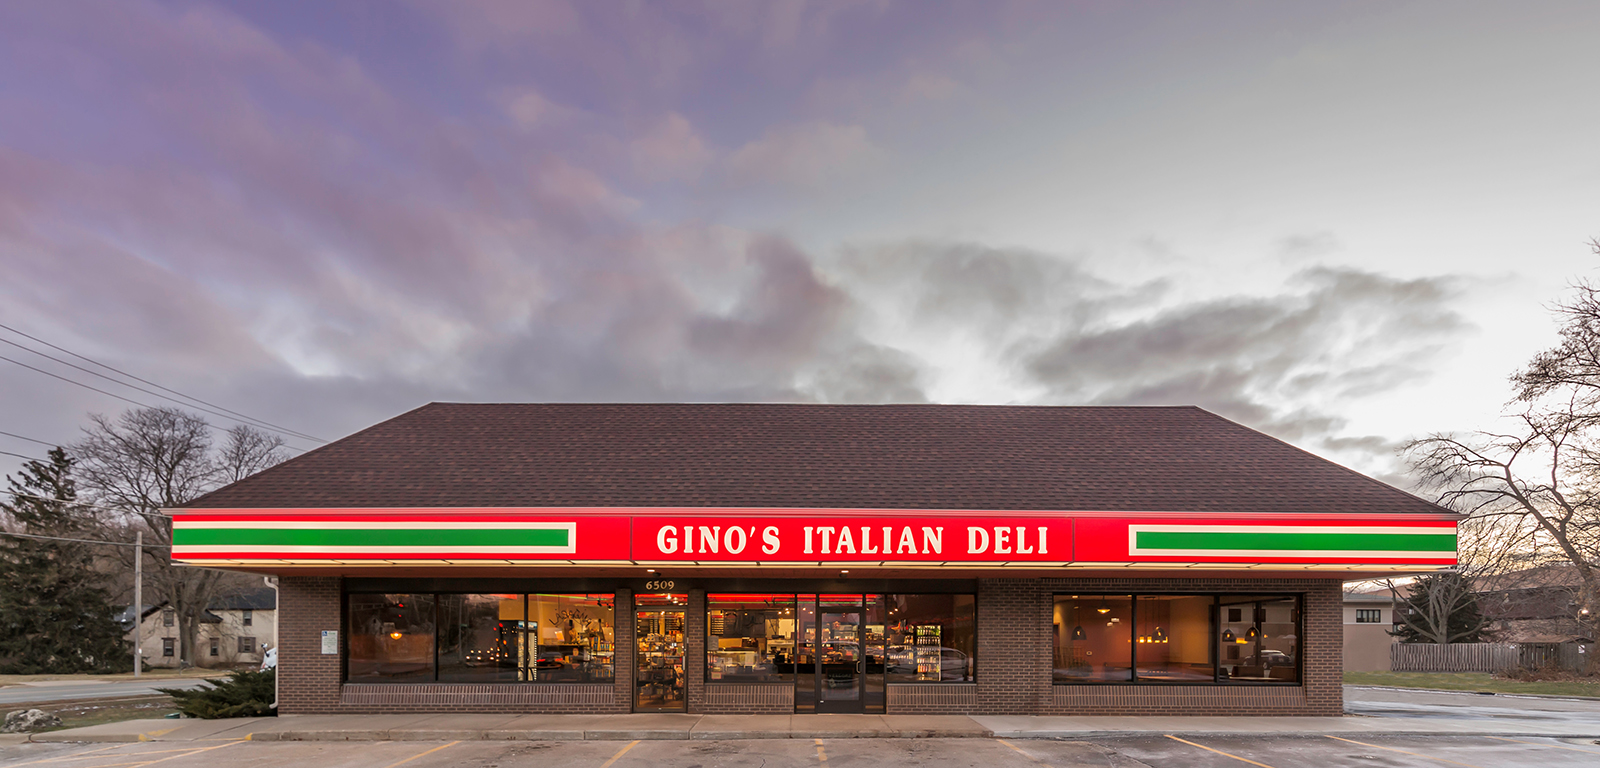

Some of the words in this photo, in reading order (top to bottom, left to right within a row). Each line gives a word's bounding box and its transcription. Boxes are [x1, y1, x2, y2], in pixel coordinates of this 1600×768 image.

[657, 525, 781, 555] GINO'S
[803, 526, 944, 554] ITALIAN
[967, 526, 1048, 554] DELI
[645, 580, 675, 590] 6509
